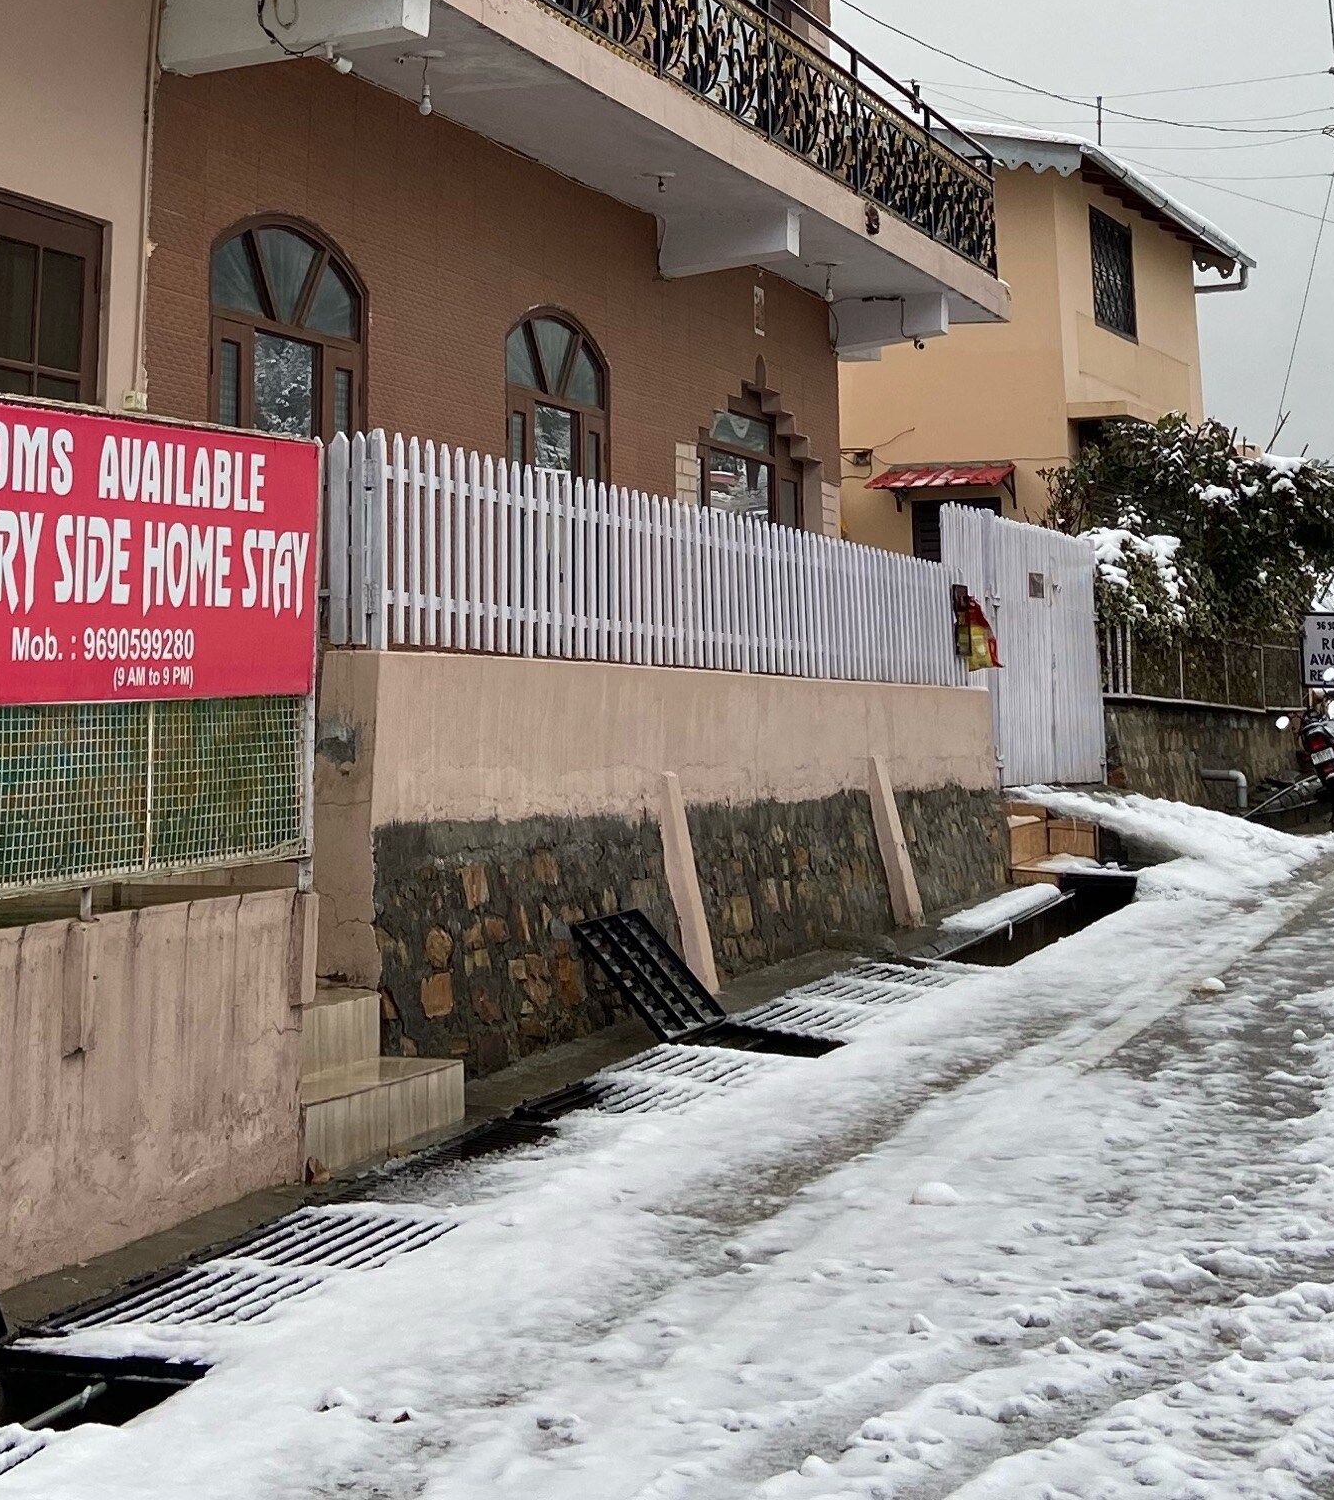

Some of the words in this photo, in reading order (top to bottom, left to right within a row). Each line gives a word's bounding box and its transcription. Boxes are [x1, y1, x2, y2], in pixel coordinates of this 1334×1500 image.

[98, 434, 266, 514] AVAILABLE
[54, 513, 132, 605] SIDE
[142, 521, 233, 617] HOME
[240, 528, 311, 618] STAY
[82, 626, 195, 661] 9690599280
[113, 665, 125, 691] (9
[126, 666, 146, 687] AM
[148, 666, 161, 687] to
[162, 666, 170, 687] 9
[172, 665, 194, 690] PM)
